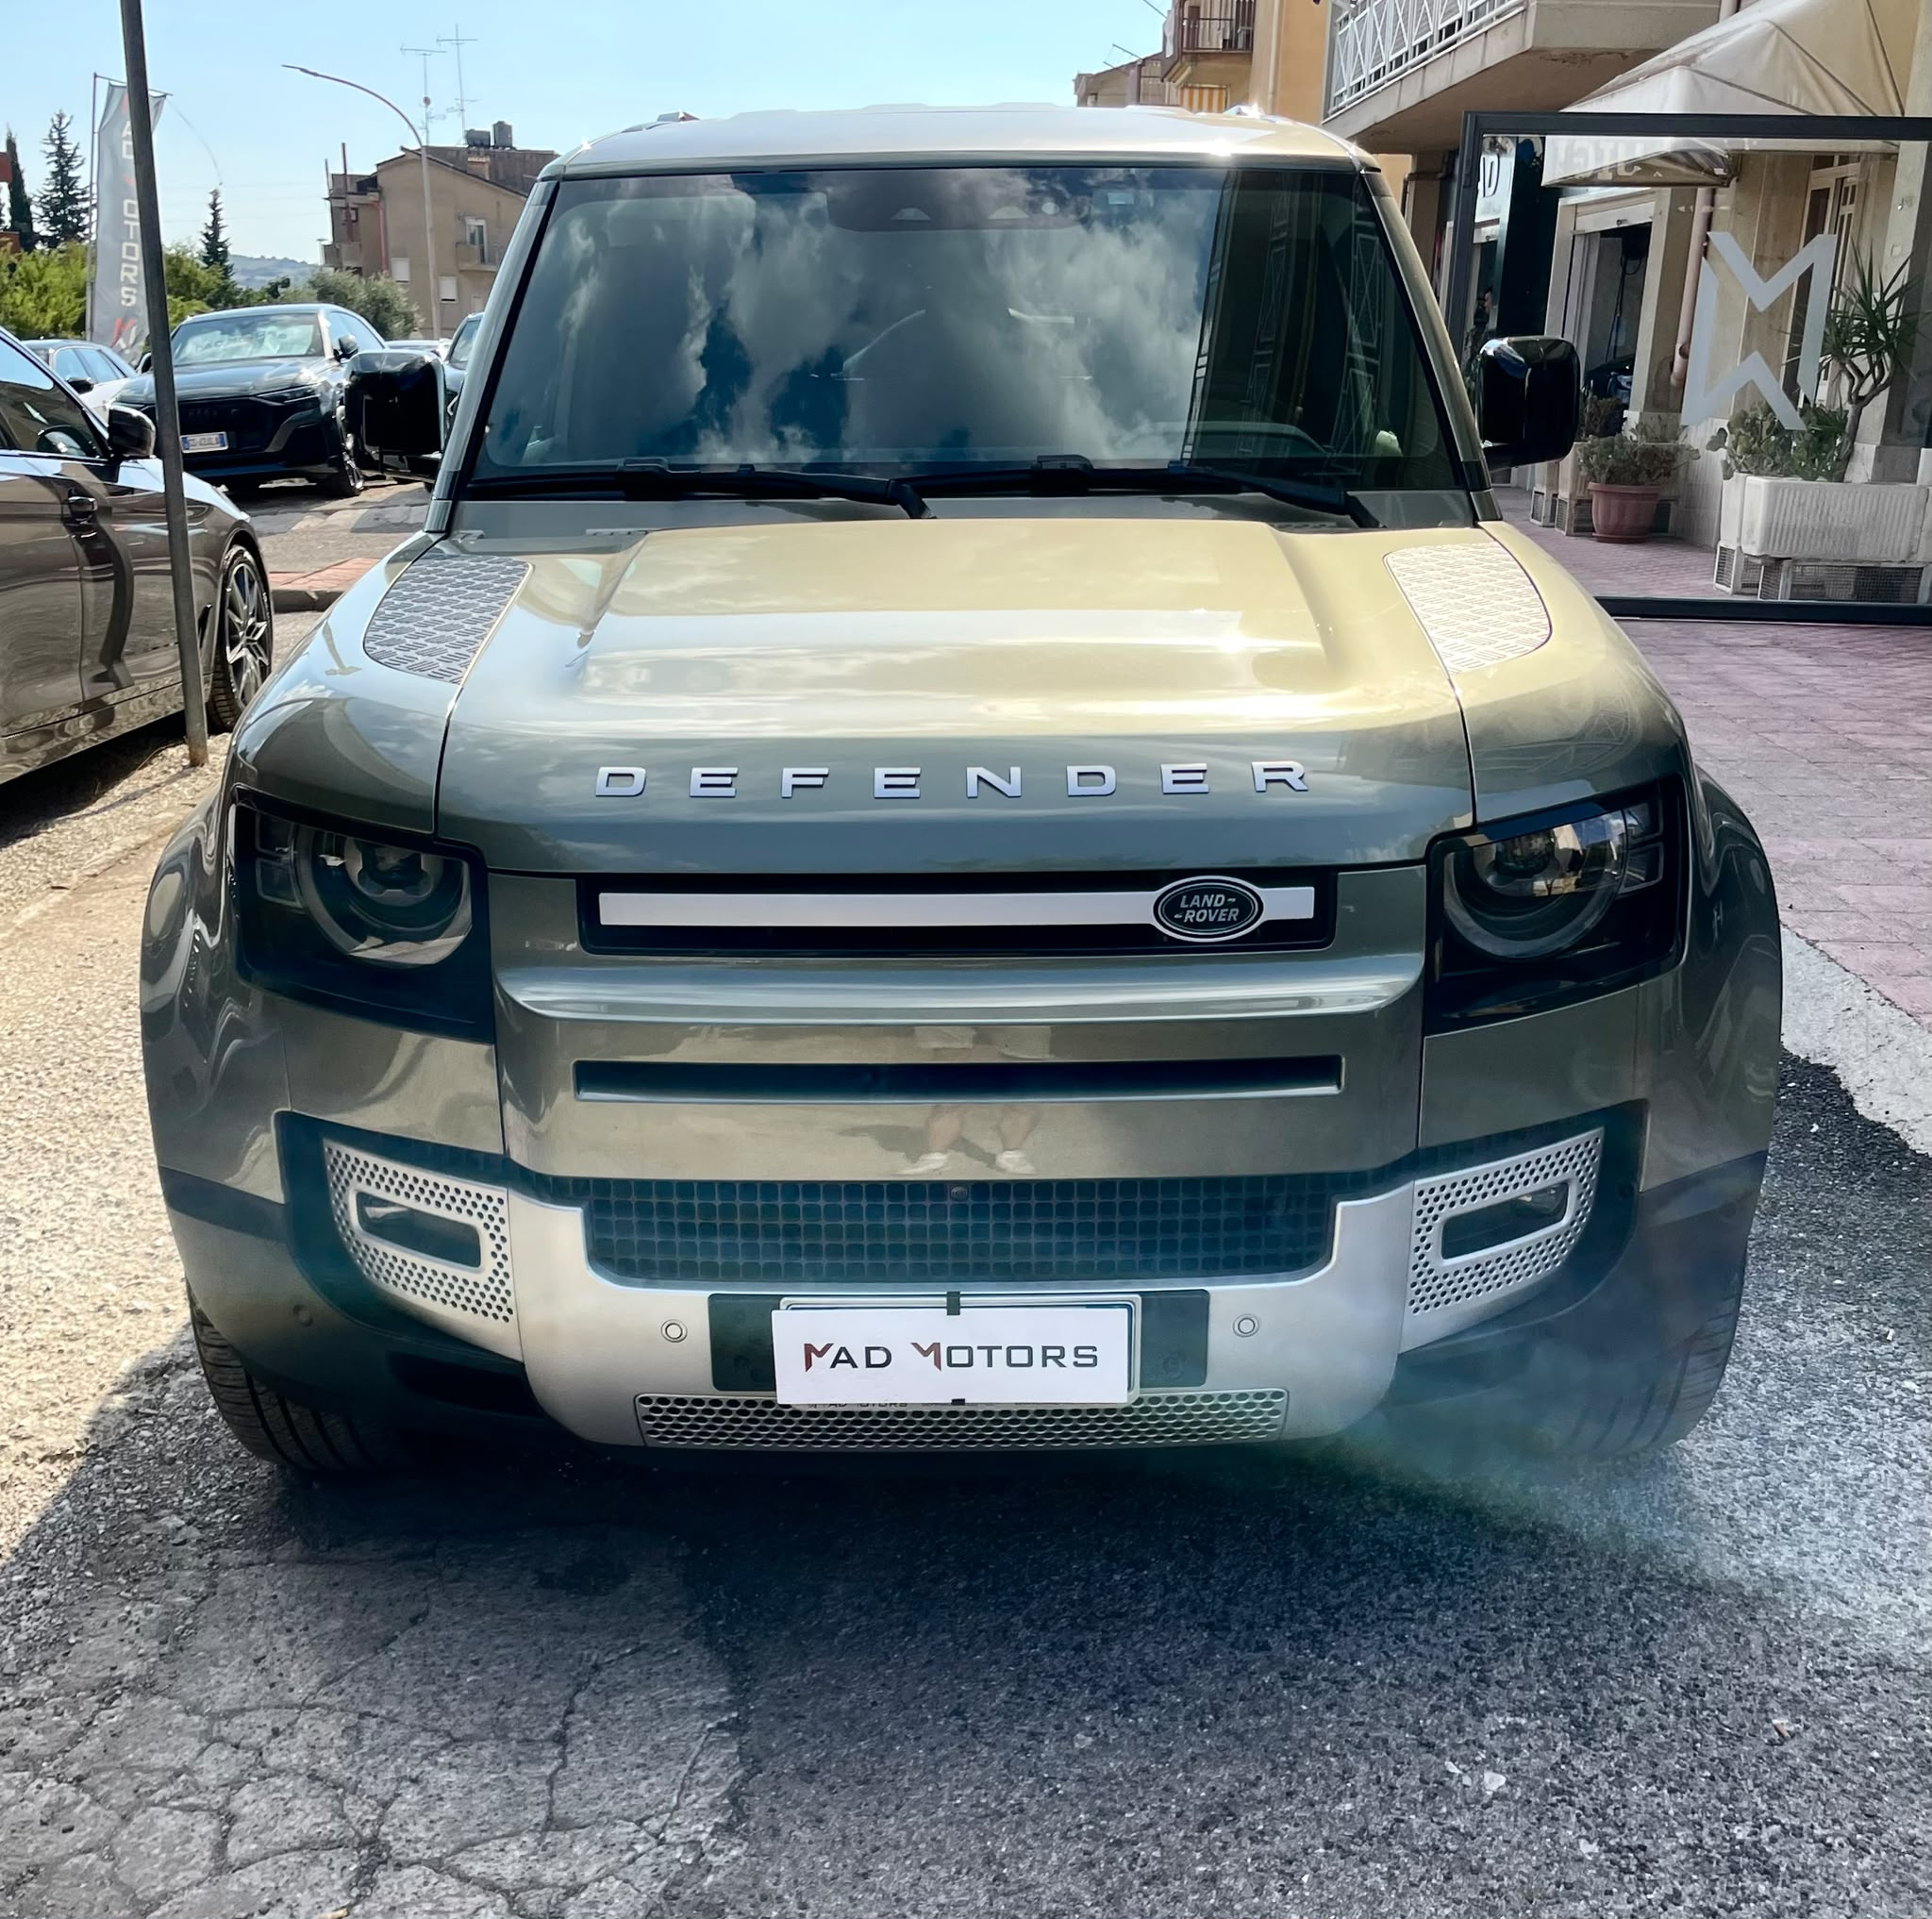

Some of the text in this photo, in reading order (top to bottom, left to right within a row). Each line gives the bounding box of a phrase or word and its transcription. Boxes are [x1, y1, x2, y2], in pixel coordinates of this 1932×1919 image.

[594, 759, 1309, 799] DEFENDER
[804, 1342, 1099, 1373] MAD MOTORS
